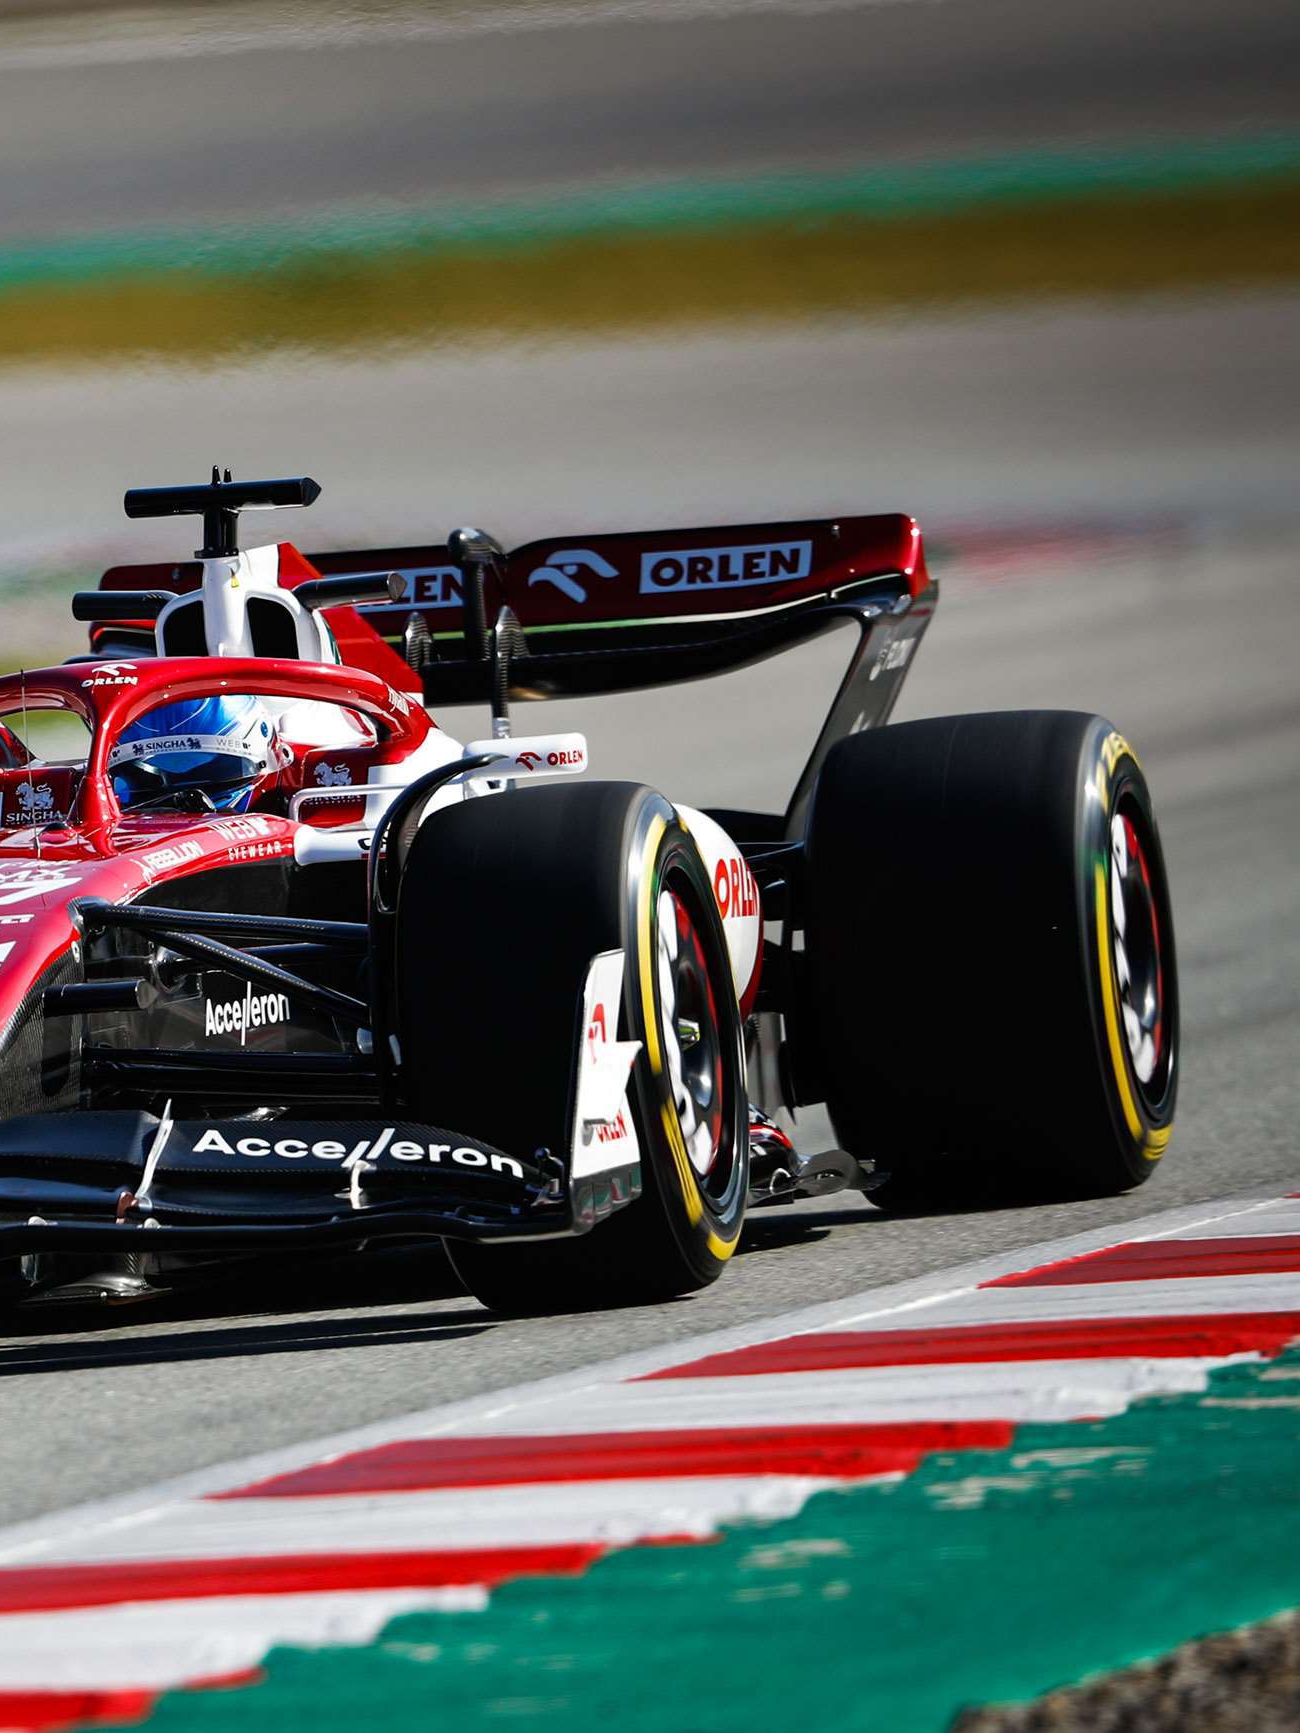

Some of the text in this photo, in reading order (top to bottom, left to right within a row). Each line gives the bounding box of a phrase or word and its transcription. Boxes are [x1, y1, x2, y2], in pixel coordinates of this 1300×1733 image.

[651, 548, 800, 587] ORLEN
[81, 676, 138, 688] ORLEN
[145, 740, 186, 751] SINGHA
[547, 750, 584, 766] ORLEN
[6, 810, 65, 822] SINGHA
[227, 841, 282, 861] EYEWEAR
